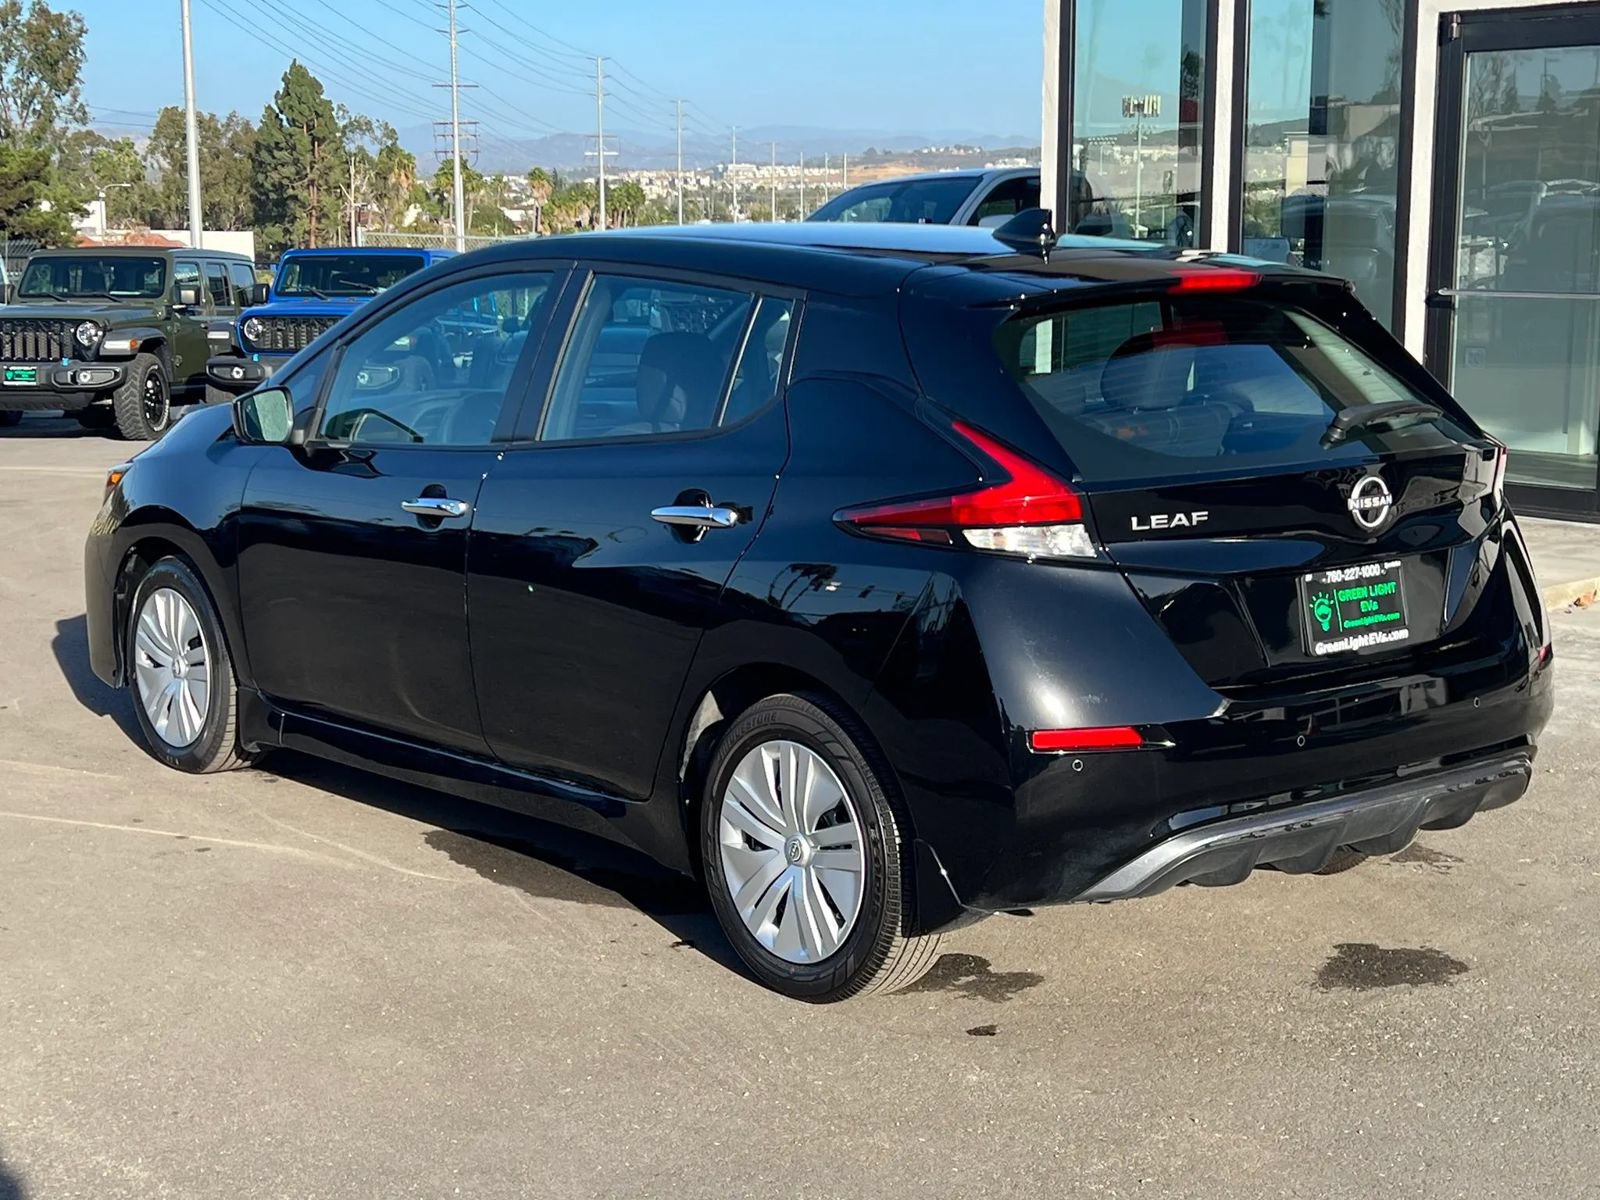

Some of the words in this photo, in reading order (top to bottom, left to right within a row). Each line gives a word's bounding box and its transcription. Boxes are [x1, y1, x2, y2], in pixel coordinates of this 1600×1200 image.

[1347, 494, 1392, 510] NISSAN
[1130, 511, 1208, 530] LEAF
[1338, 586, 1367, 602] GREEN
[1369, 581, 1397, 597] LIGHT
[1360, 600, 1379, 612] EVs
[1315, 628, 1409, 655] GreenLightEVs.com
